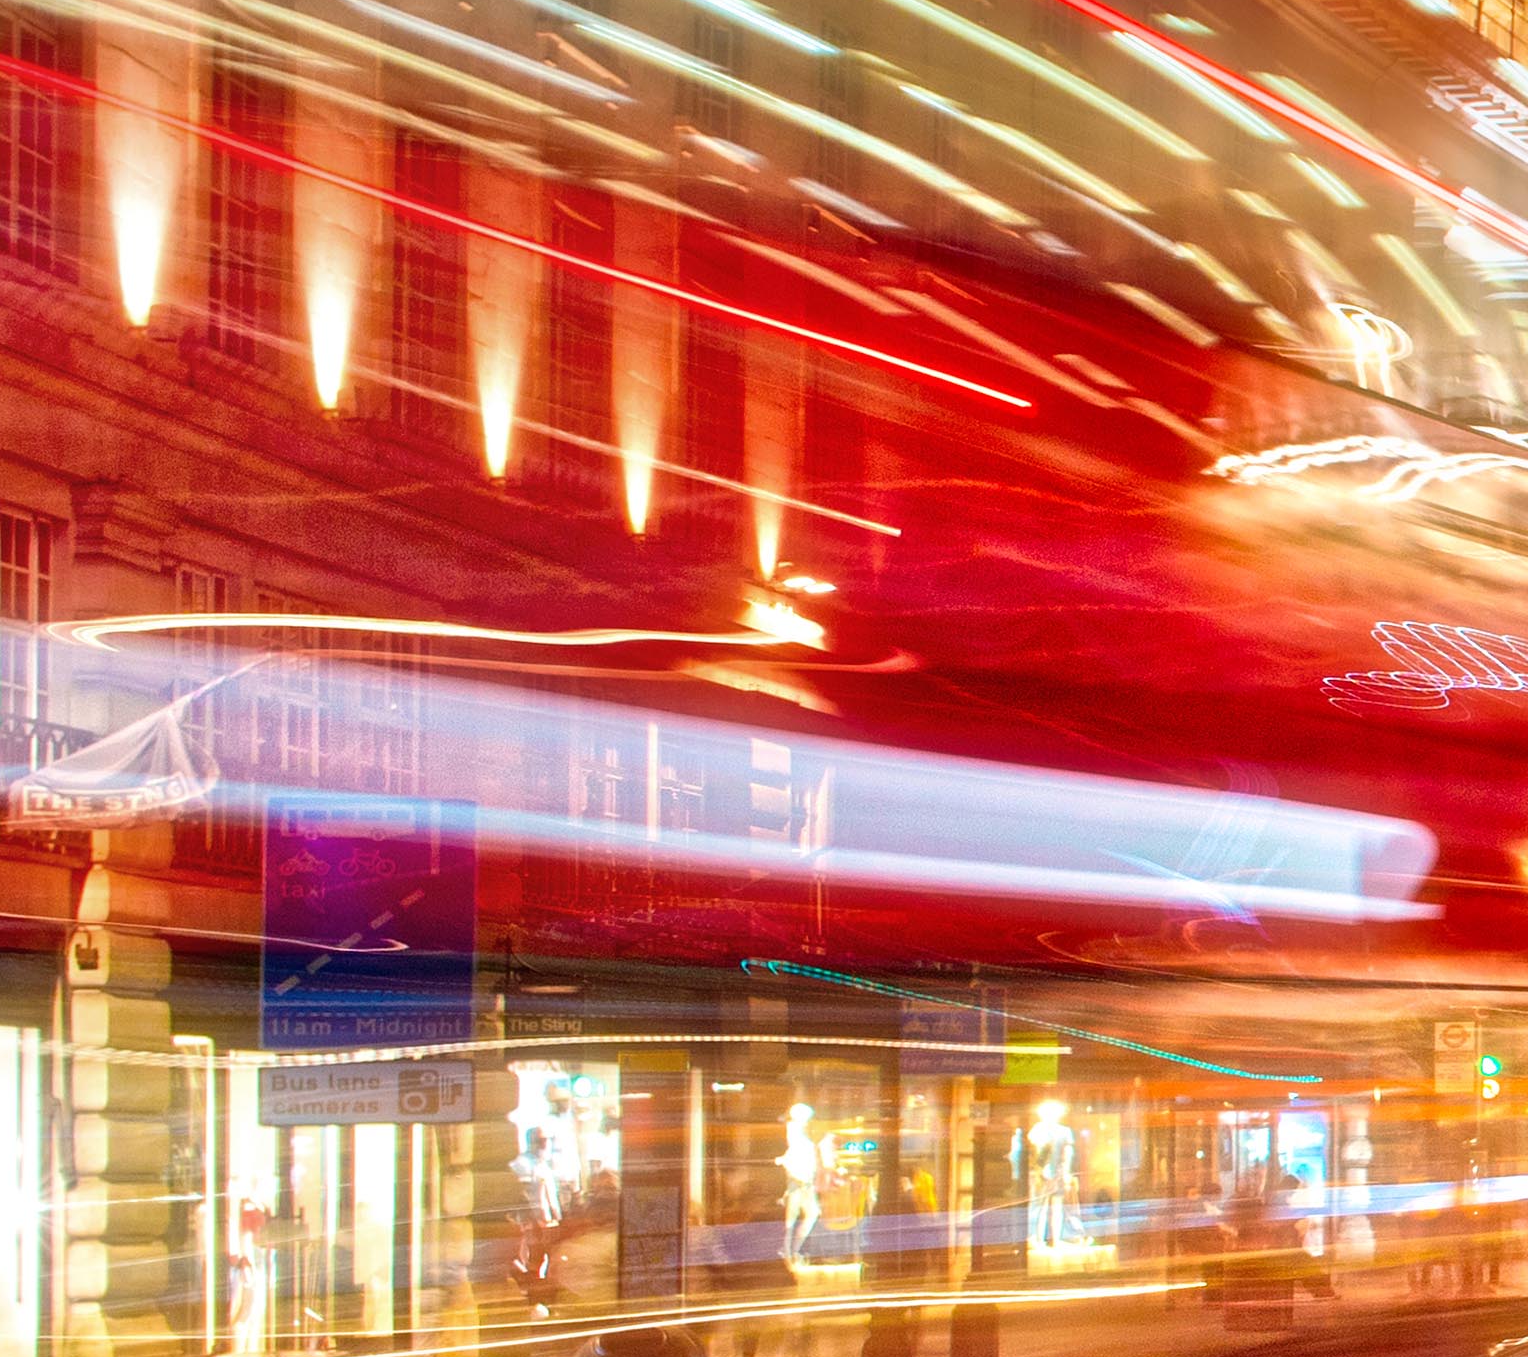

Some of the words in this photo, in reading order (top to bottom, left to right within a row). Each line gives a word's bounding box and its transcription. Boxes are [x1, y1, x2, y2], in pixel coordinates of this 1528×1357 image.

[104, 778, 184, 811] STNG
[273, 1018, 332, 1035] 11am
[356, 1017, 464, 1038] Midnight
[511, 1018, 539, 1031] The
[541, 1018, 583, 1034] Sting
[273, 1075, 318, 1091] Bus
[273, 1099, 380, 1116] cameras
